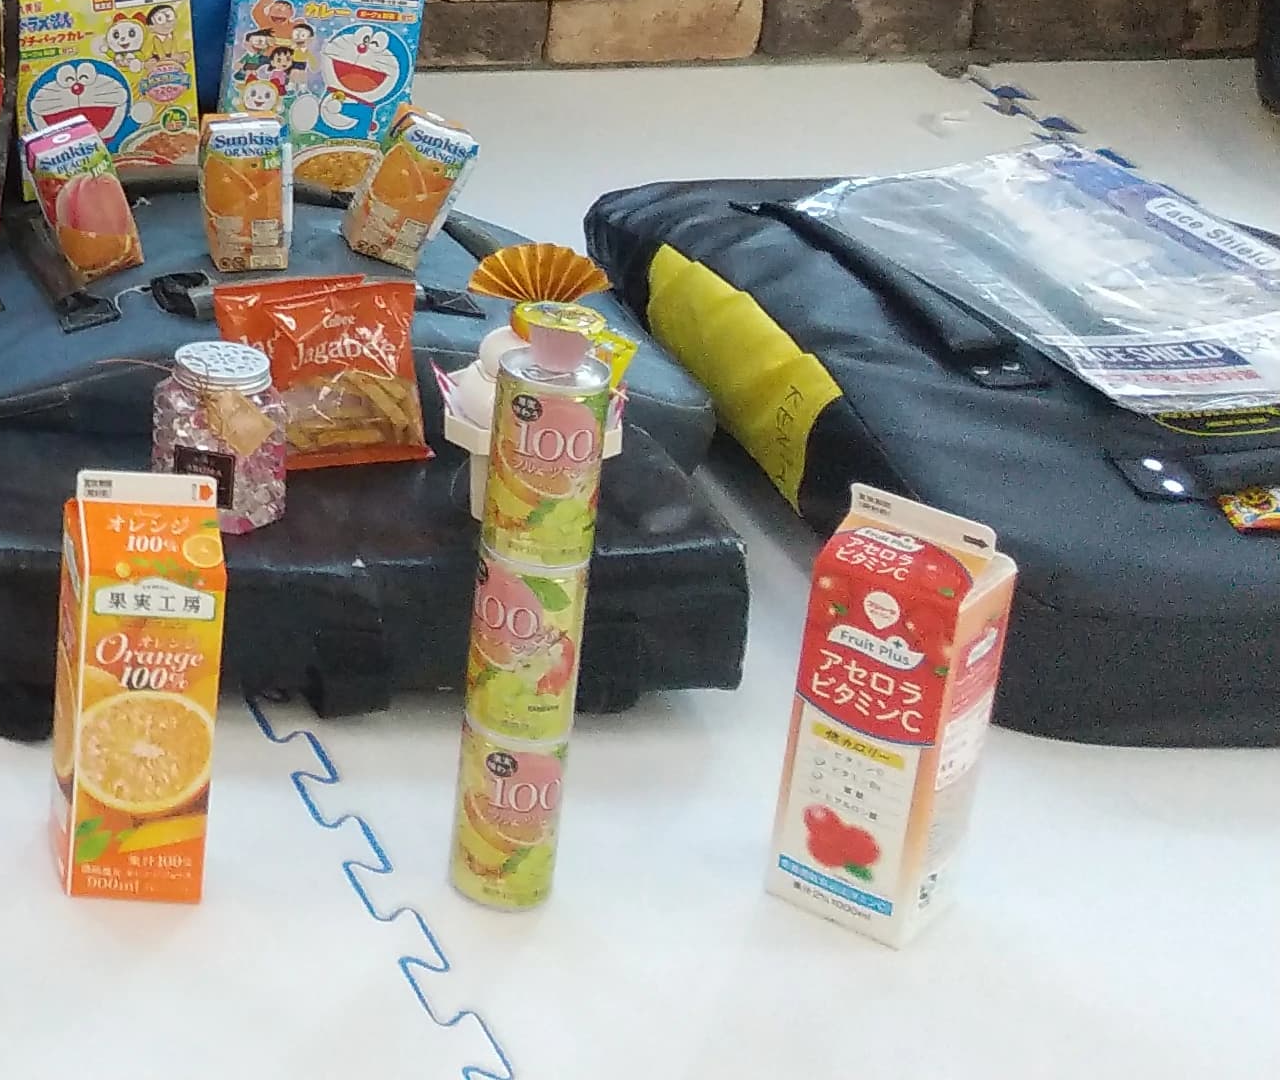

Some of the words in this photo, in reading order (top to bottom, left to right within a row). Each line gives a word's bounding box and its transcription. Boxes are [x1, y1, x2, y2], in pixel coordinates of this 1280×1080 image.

[304, 2, 352, 20] カレー
[214, 130, 281, 150] Sunkist
[224, 145, 272, 159] ORANGE
[41, 141, 102, 170] Sunkist
[1155, 200, 1204, 231] Face
[1206, 227, 1276, 267] Shield
[106, 513, 191, 536] オレンジ
[125, 534, 179, 554] 100%
[845, 534, 915, 568] アセロラ
[835, 545, 910, 582] ビタミンC
[107, 590, 202, 615] 果実工房
[95, 631, 206, 672] Orange
[838, 629, 876, 655] Fruit
[877, 641, 913, 669] Plus
[119, 666, 191, 692] 100%
[815, 648, 924, 706] アセロラ
[809, 670, 923, 735] ビタミンC
